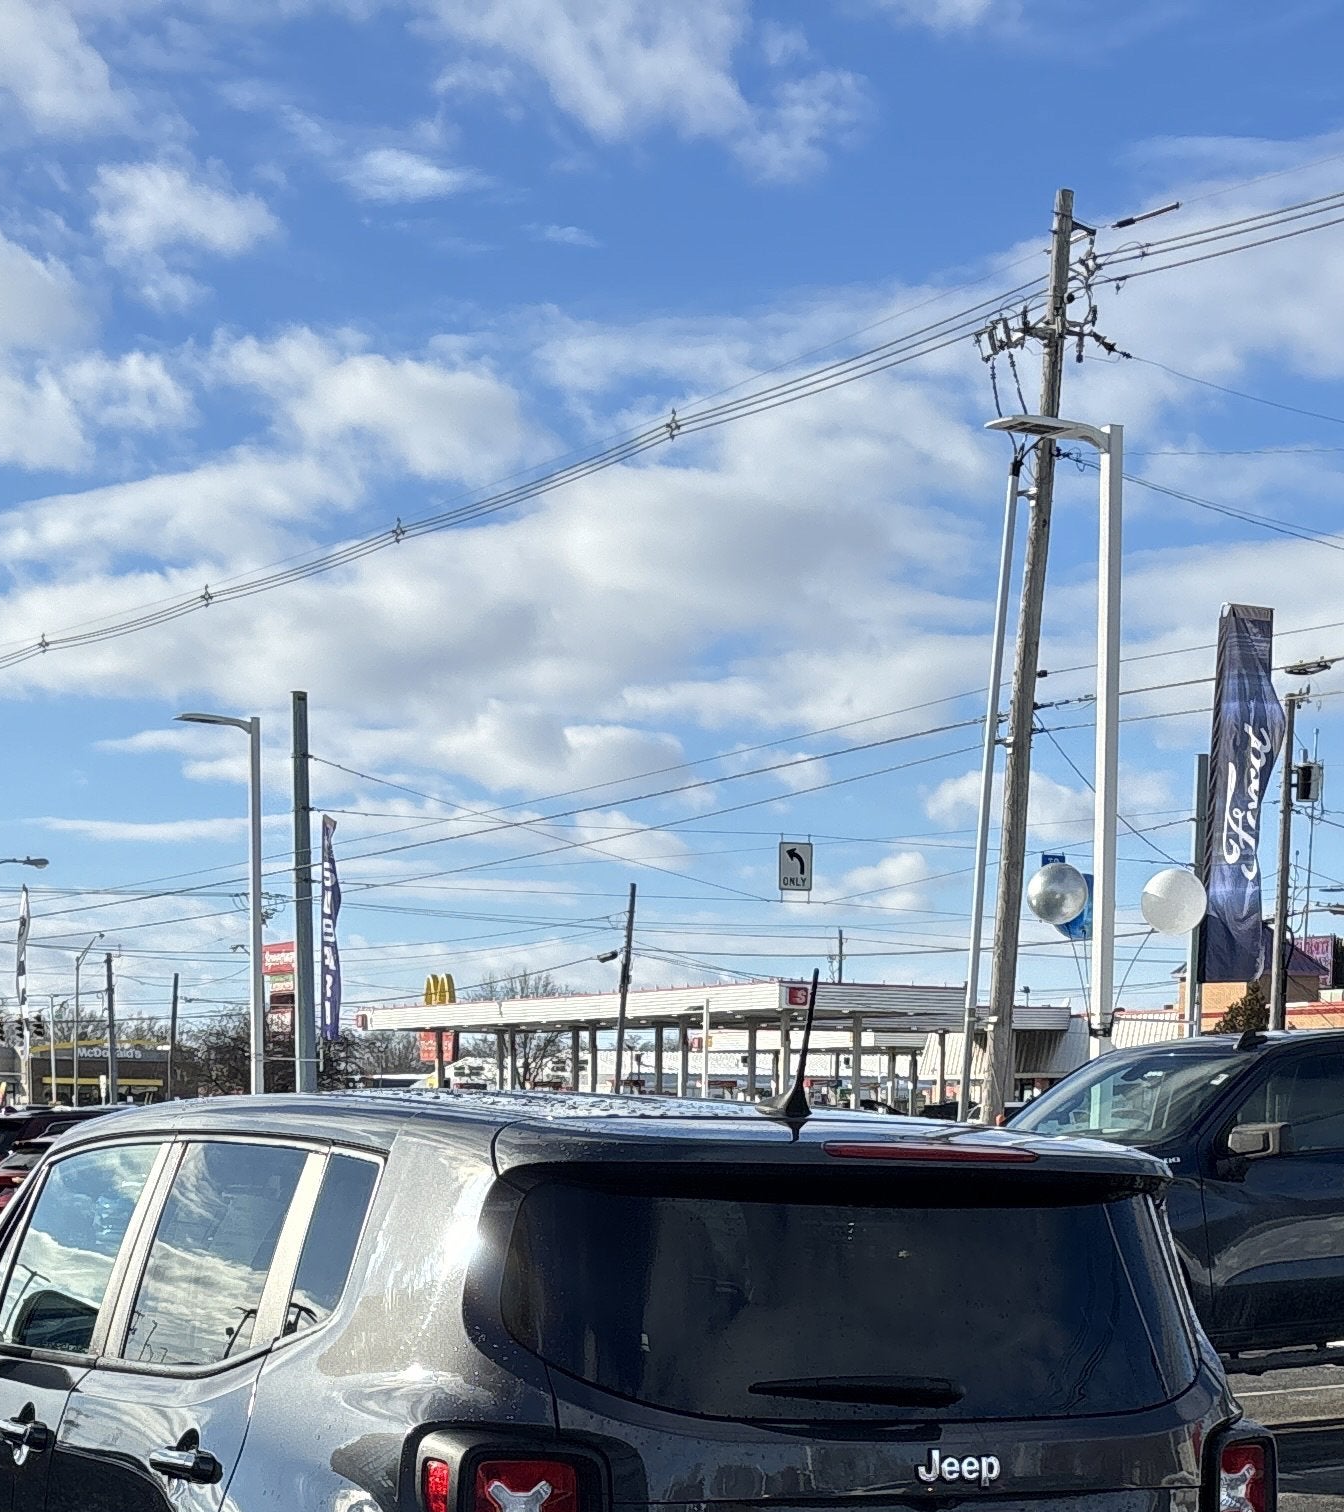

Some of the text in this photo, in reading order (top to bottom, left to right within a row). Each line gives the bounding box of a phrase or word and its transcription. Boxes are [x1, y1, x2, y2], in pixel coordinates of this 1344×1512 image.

[783, 877, 807, 887] ONLY
[77, 1047, 142, 1059] McDoald's
[917, 1449, 1001, 1487] Jeep
